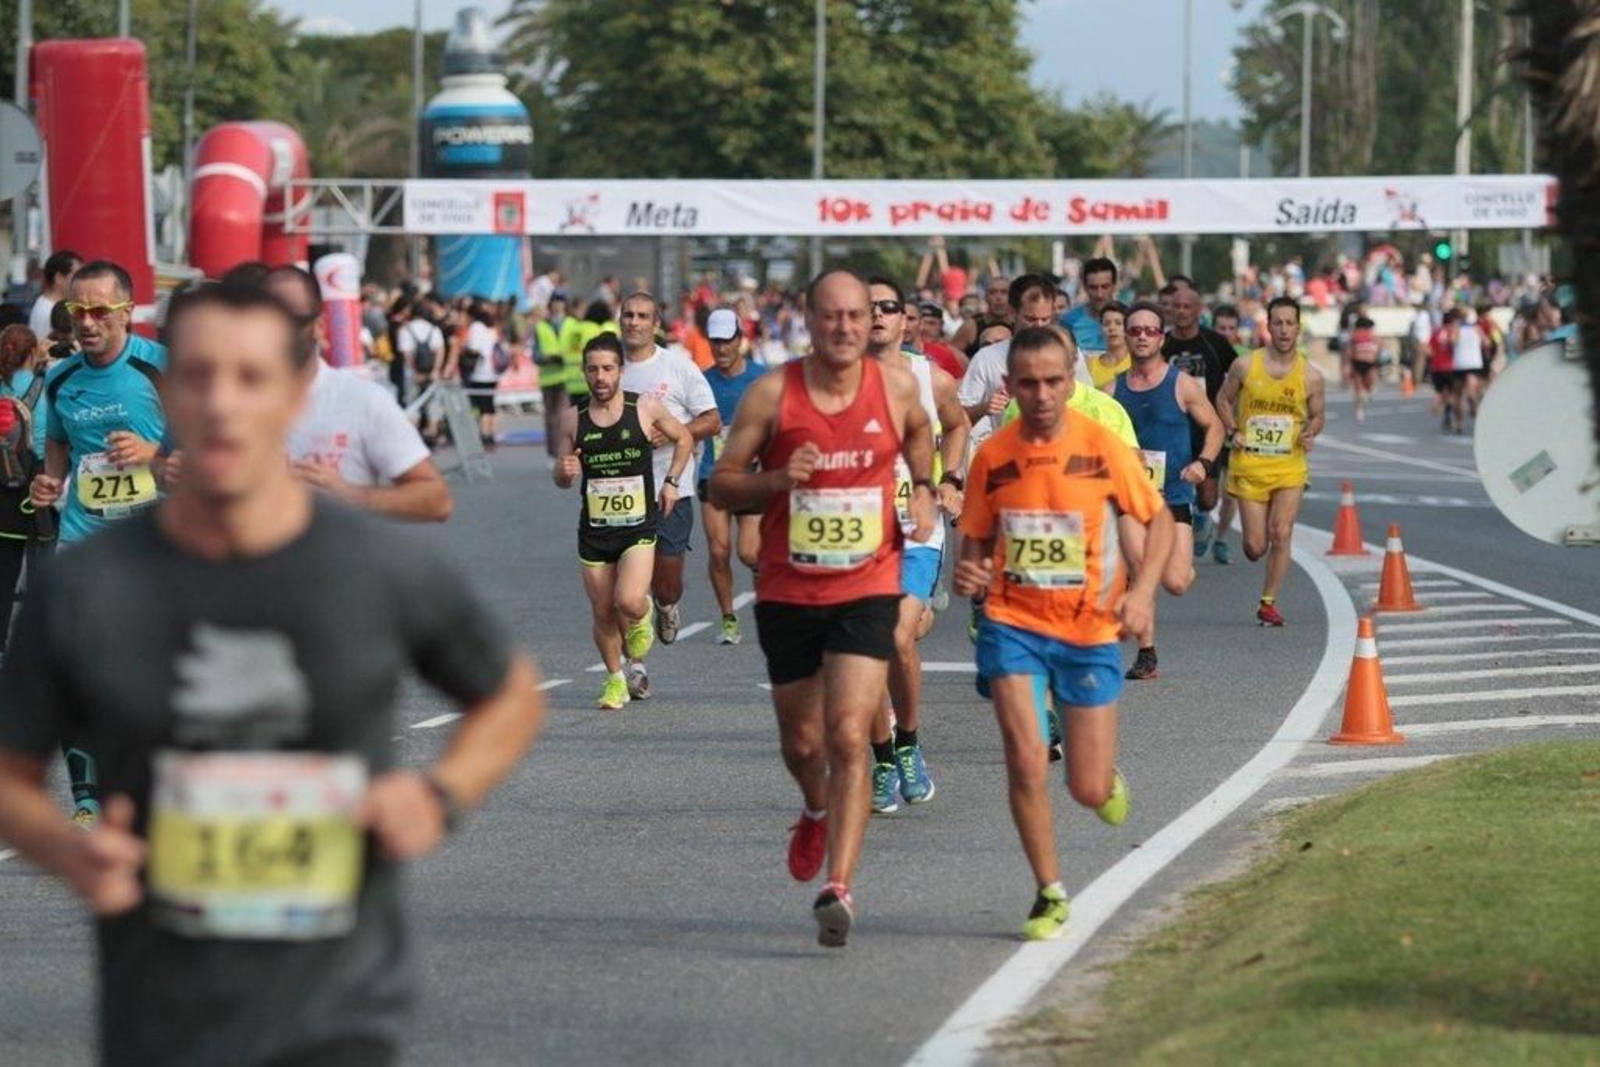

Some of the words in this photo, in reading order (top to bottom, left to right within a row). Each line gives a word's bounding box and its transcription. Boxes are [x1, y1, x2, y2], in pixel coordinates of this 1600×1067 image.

[1465, 191, 1536, 205] CONCELLO
[625, 202, 700, 228] Meta
[889, 198, 993, 225] praia
[1010, 197, 1050, 221] de
[1067, 197, 1169, 224] Samil
[1471, 207, 1491, 219] DE
[1256, 428, 1284, 444] 547
[91, 474, 140, 499] 271
[598, 495, 634, 512] 760
[808, 517, 863, 543] 933
[1012, 538, 1066, 563] 758
